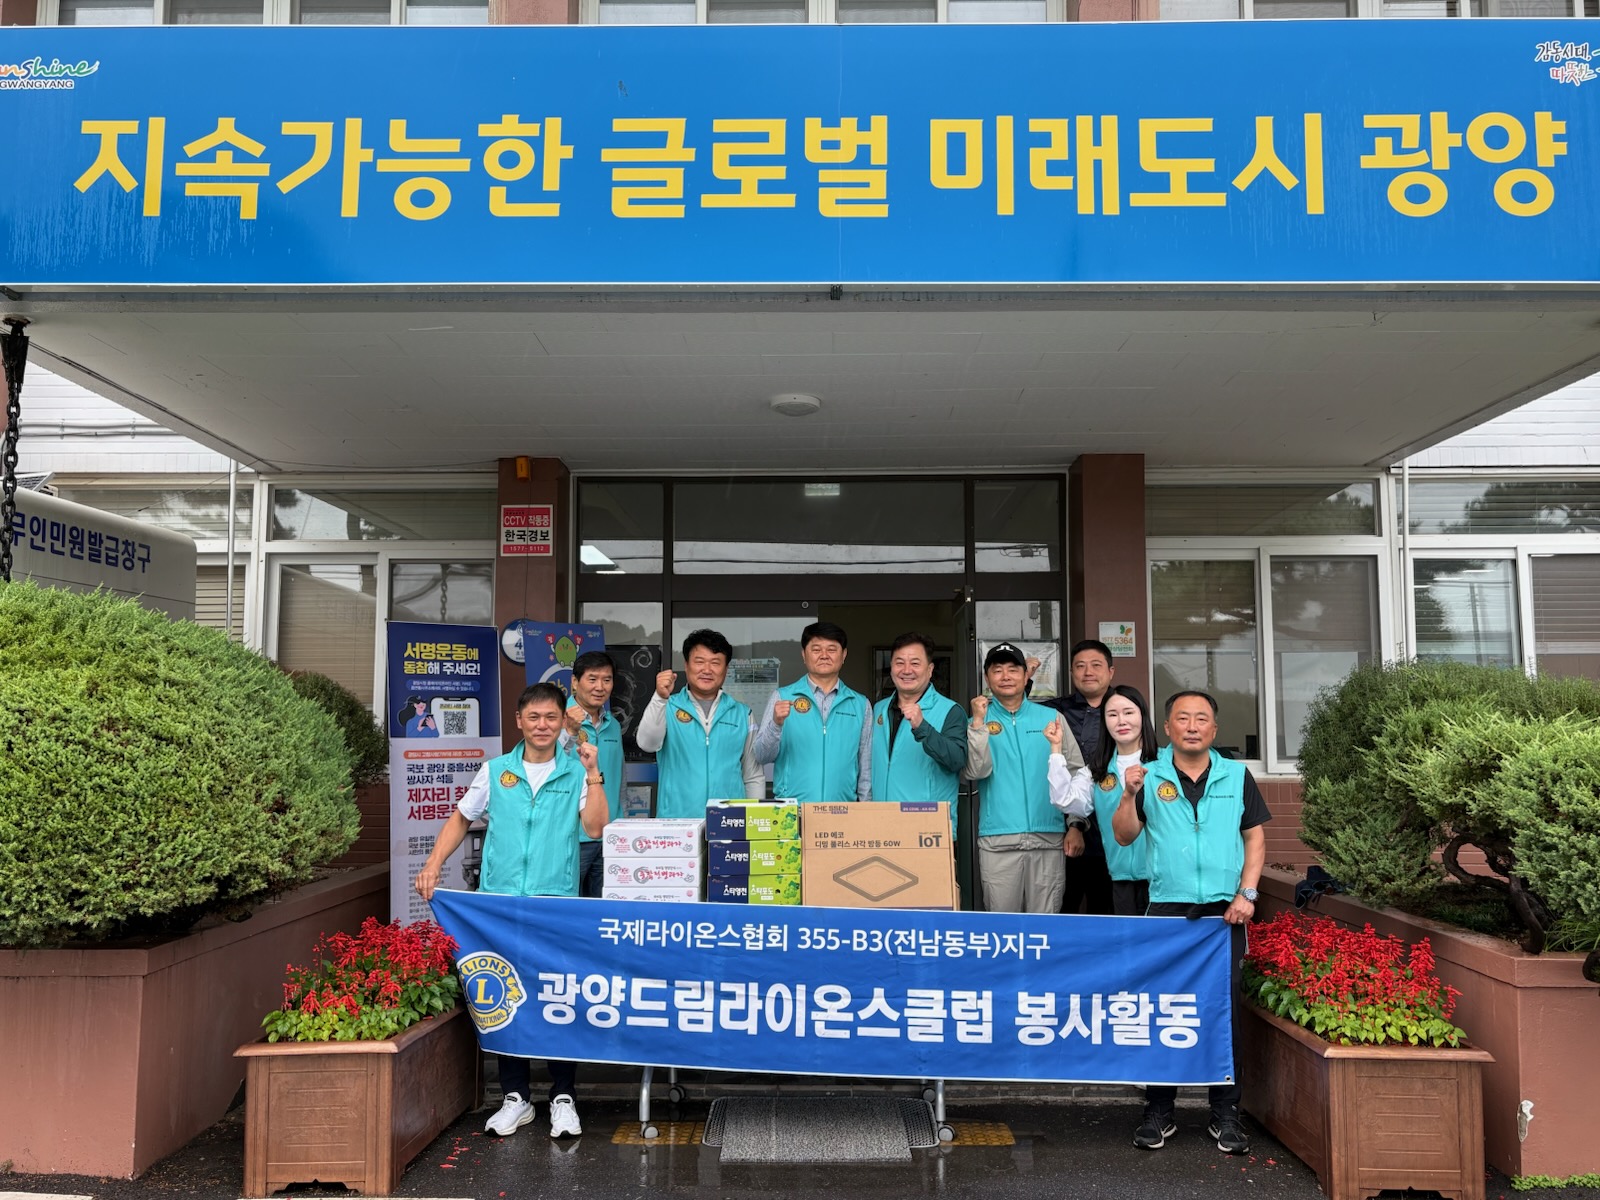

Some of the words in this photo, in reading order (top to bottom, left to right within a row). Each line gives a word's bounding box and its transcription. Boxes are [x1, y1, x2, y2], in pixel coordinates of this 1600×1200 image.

[73, 114, 574, 220] 지속가능한
[600, 116, 889, 218] 글로벌
[930, 113, 1325, 215] 미래도시
[1360, 111, 1568, 218] 광양
[504, 515, 526, 526] CCTV
[528, 514, 549, 526] 작동중
[504, 529, 550, 542] 한국경보
[10, 512, 151, 573] 무인민원발급창구
[404, 642, 479, 661] 서명운동에
[404, 661, 439, 675] 동참해
[442, 662, 480, 675] 주세요!
[407, 763, 424, 774] 국보
[427, 763, 445, 773] 광양
[407, 774, 433, 785] 쌍사자
[436, 774, 453, 784] 석등
[408, 787, 450, 803] 제자리
[721, 816, 744, 827] 스타영천
[748, 816, 771, 827] 스타포도
[852, 840, 865, 848] 사각
[919, 835, 942, 847] IoT
[725, 850, 748, 862] 스타영천
[752, 850, 775, 861] 스타포도
[723, 885, 747, 896] 스타영천
[750, 885, 774, 896] 스타포도
[598, 918, 788, 951] 국제라이온스협회
[797, 927, 1051, 960] 355-B3(전남동부)지구
[464, 958, 508, 974] LIONS
[475, 978, 494, 1004] L
[537, 972, 993, 1043] 광양드림라이온스클럽
[1014, 991, 1201, 1049] 봉사활동
